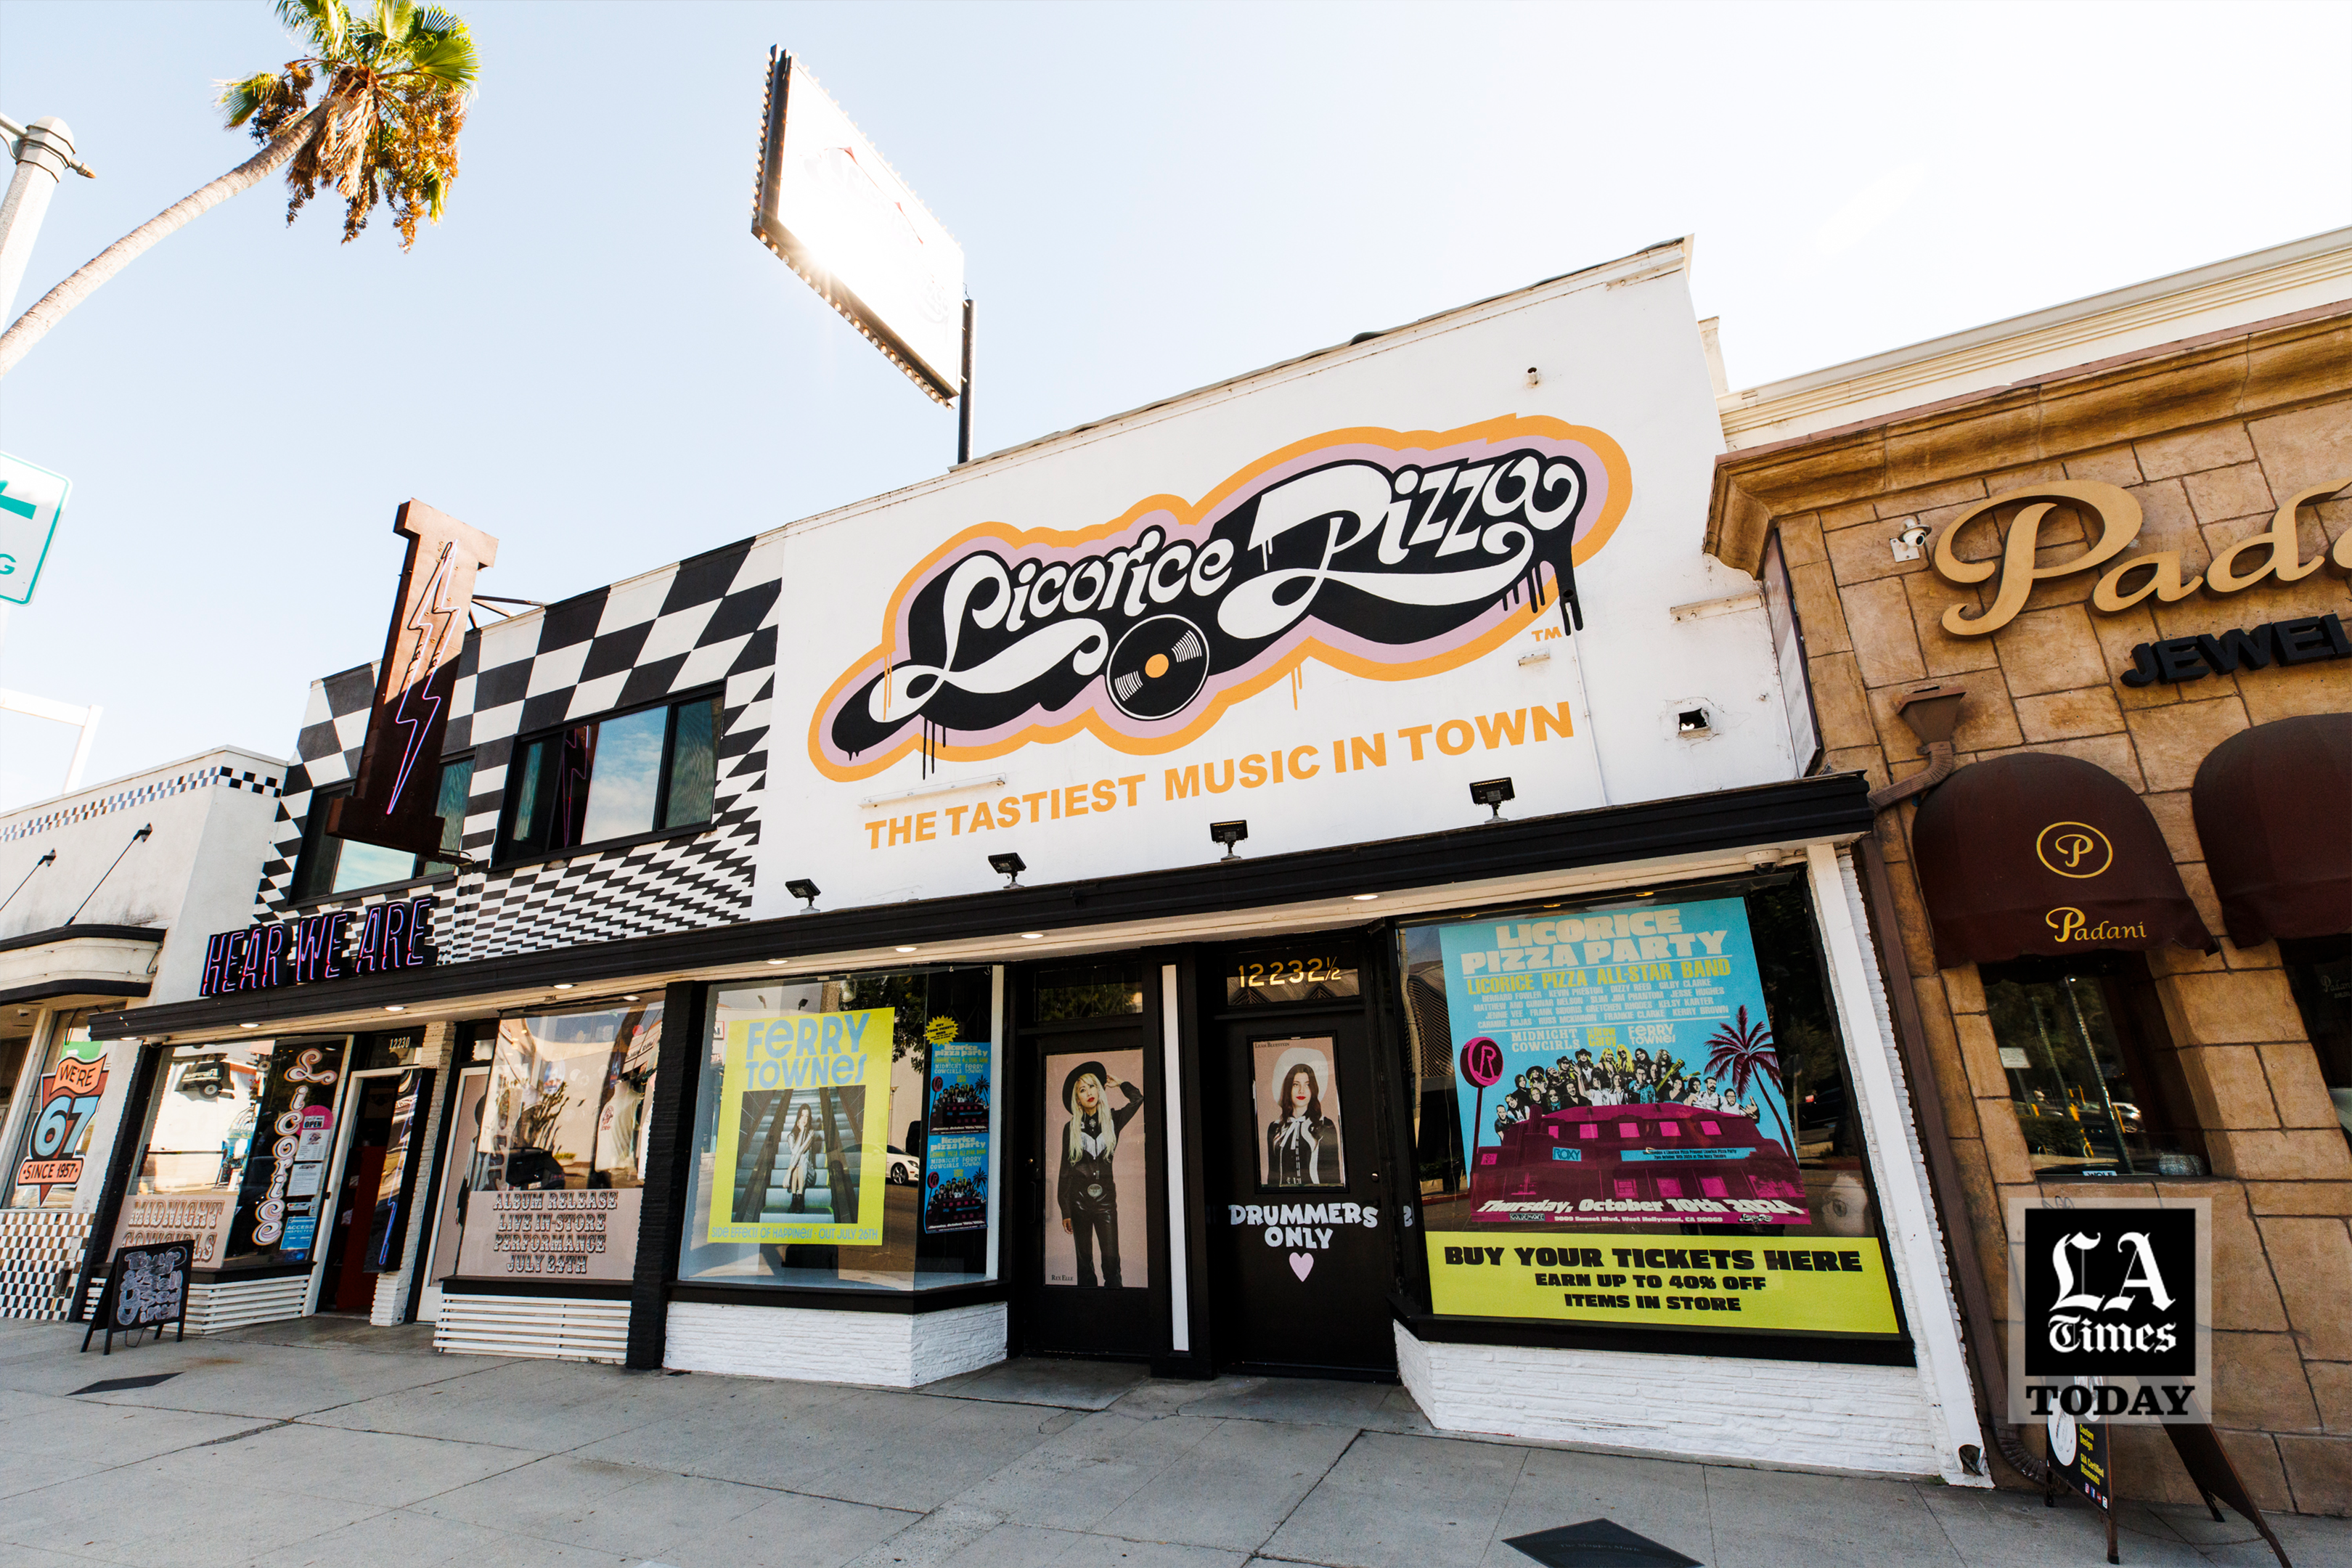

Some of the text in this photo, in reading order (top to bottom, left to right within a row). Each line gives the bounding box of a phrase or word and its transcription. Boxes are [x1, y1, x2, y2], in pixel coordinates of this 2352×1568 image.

[1934, 476, 2352, 635] Pad
[869, 456, 1580, 723] Licorice Pizza
[1531, 626, 1562, 642] TM
[865, 701, 1574, 849] THE TASTIEST MUSIC IN TOWN
[2055, 834, 2094, 867] P
[1495, 909, 1683, 949] LICORICE
[2045, 907, 2147, 942] Padani
[200, 897, 436, 996] HEAR WE ARE
[1461, 930, 1728, 975] PIZZA PARTY
[1467, 958, 1731, 995] LICORICE PIZZA ALL-STAR BAND
[1474, 987, 1725, 1012] MATTHEW AND GUNNAR NELSON SLIM JIM PHANTOM JESSE HUGHES
[1482, 979, 1712, 1003] BERNARD FOWLER KEVIN PRESTON DIZZY REED GILBY CLARKE
[1477, 1005, 1729, 1029] CARMINE ROJAS RUSS MCKINNON FRANKIE CLARKE KERRY BROWN
[1485, 997, 1714, 1020] JENNIE VEE FRANK SIDORIS GRETCHEN RHODES KELSY KARTER
[389, 1036, 411, 1050] 12230
[1511, 1028, 1577, 1042] MIDNIGHT
[1588, 1035, 1617, 1047] Carey
[1593, 1027, 1616, 1037] Drew
[1511, 1039, 1580, 1053] COWGIRLS
[60, 1063, 96, 1088] WE'RE
[33, 1095, 99, 1157] 67
[931, 1140, 986, 1151] pizza party
[1553, 1148, 1580, 1160] ROXY
[25, 1163, 76, 1180] SINCE 1957
[492, 1191, 618, 1210] ALBUM RELEASE
[1477, 1199, 1805, 1214] Thursday, October 10th 2024
[128, 1199, 225, 1229] MIDNIGHT
[498, 1213, 606, 1232] LIVE IN-STORE
[1228, 1202, 1379, 1228] DRUMMERS
[493, 1233, 606, 1253] PERFORMANCE
[760, 1228, 771, 1238] OF
[819, 1228, 835, 1239] OUT
[837, 1228, 857, 1240] JULY
[858, 1228, 878, 1240] 26TH
[1265, 1226, 1334, 1249] ONLY
[506, 1254, 588, 1273] JULY 24TH
[1445, 1246, 1863, 1272] BUY YOUR TICKETS HERE
[1535, 1273, 1766, 1290] EARN UP TO 40% OFF
[1564, 1294, 1741, 1311] ITEMS IN STORE
